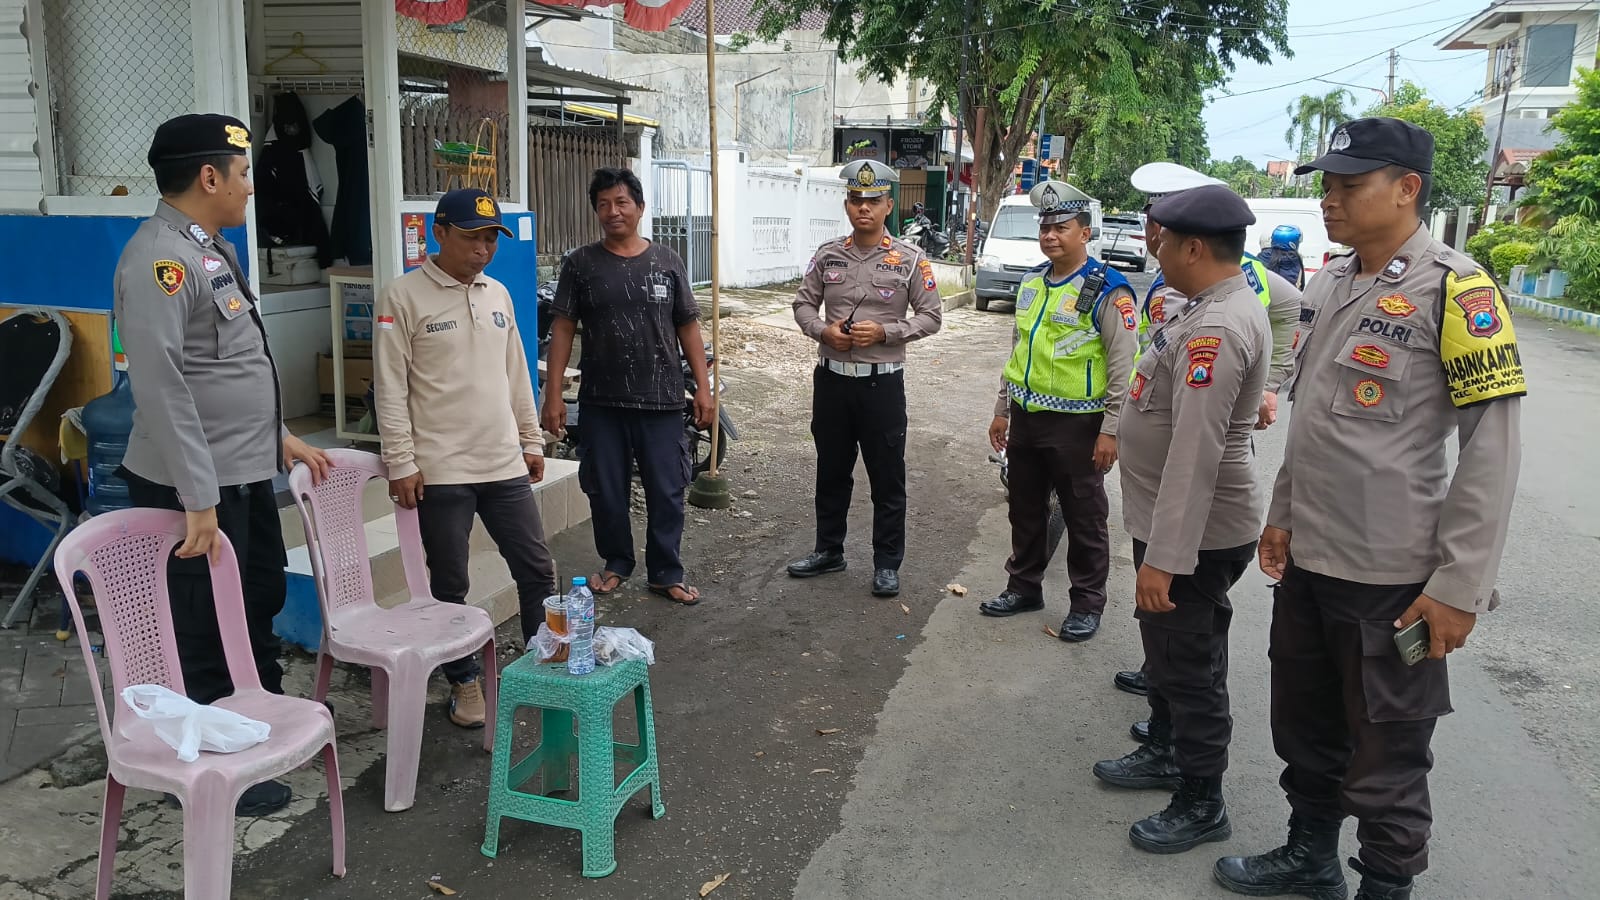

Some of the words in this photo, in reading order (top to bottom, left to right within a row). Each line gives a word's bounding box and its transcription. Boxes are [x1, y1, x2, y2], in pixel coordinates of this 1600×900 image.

[875, 263, 903, 273] POLRI
[426, 319, 458, 334] SECURITY
[1358, 317, 1412, 343] POLRI
[1462, 374, 1496, 389] JEMUR
